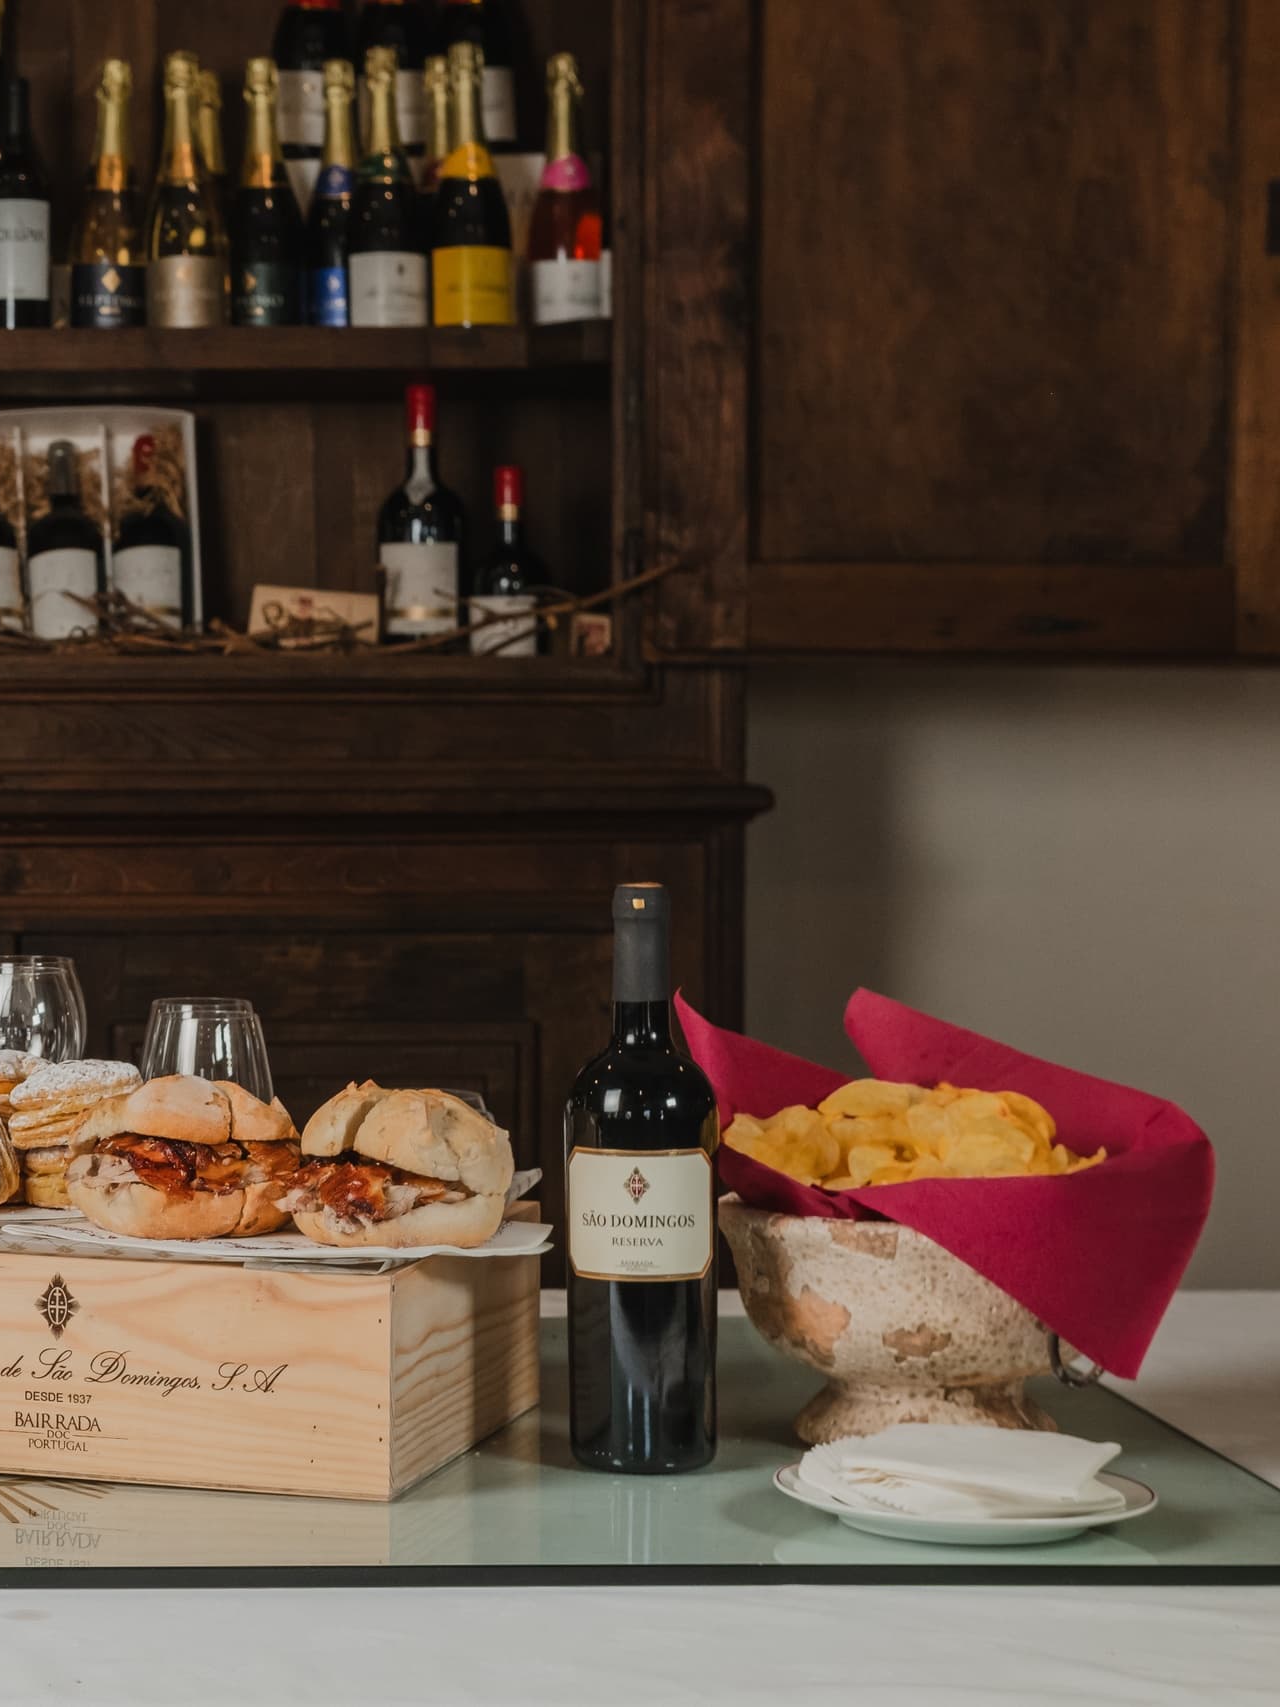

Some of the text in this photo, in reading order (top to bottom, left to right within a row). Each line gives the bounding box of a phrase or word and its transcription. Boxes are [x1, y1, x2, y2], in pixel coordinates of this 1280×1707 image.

[582, 1210, 696, 1229] SÃO DOMINGOS
[612, 1237, 664, 1247] RESERVA
[0, 1355, 24, 1378] de
[31, 1347, 73, 1381] São
[24, 1390, 92, 1405] DESDE 1937
[15, 1411, 102, 1433] BAIRRADA
[47, 1430, 71, 1440] DOC
[28, 1438, 89, 1452] PORTUGAL
